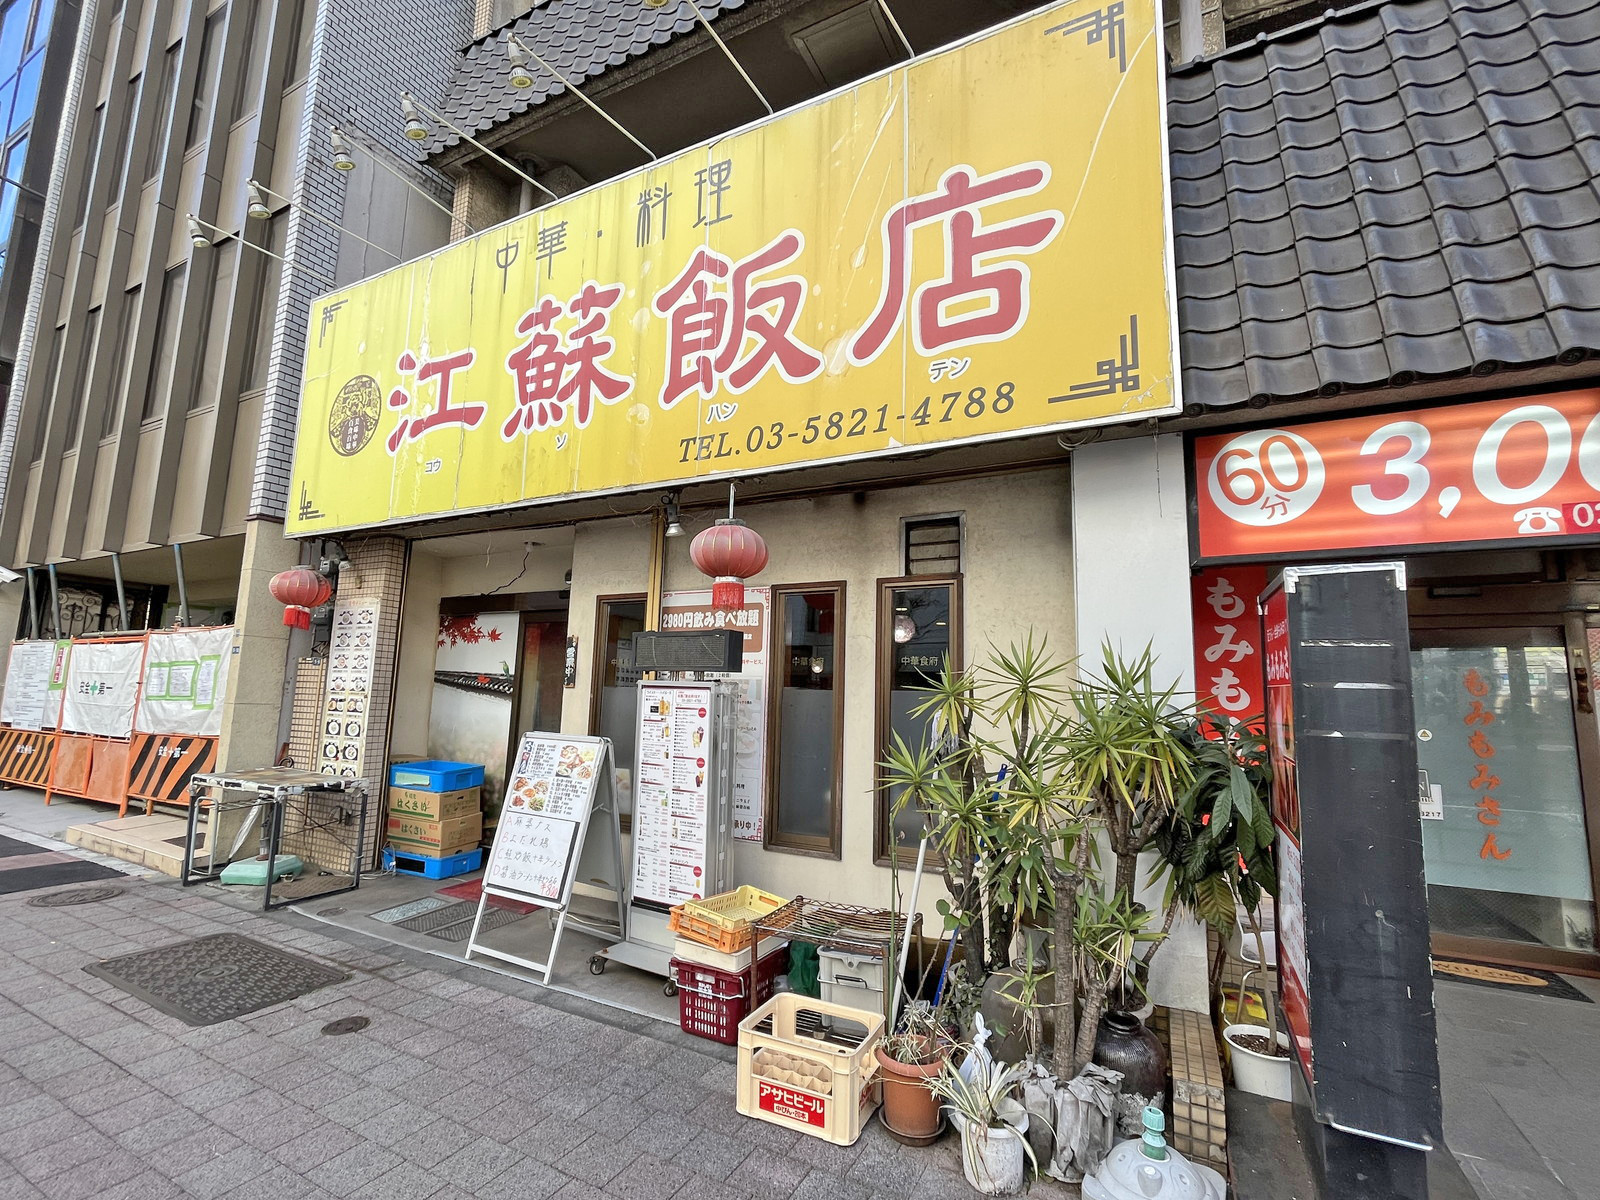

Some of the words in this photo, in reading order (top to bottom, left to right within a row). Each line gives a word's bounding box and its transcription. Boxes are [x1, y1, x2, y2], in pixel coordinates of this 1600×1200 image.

[388, 164, 1060, 455] 江蘇飯店
[929, 357, 971, 382] テン
[705, 403, 738, 424] ハン
[424, 458, 442, 474] コウ
[1351, 405, 1600, 519] 3,0
[1572, 502, 1600, 528] 0
[662, 609, 760, 629] 2980円飲み食べ放題
[901, 655, 939, 667] 中華食府
[1463, 667, 1512, 860] もみもみさん
[760, 1083, 824, 1114] アサヒビール
